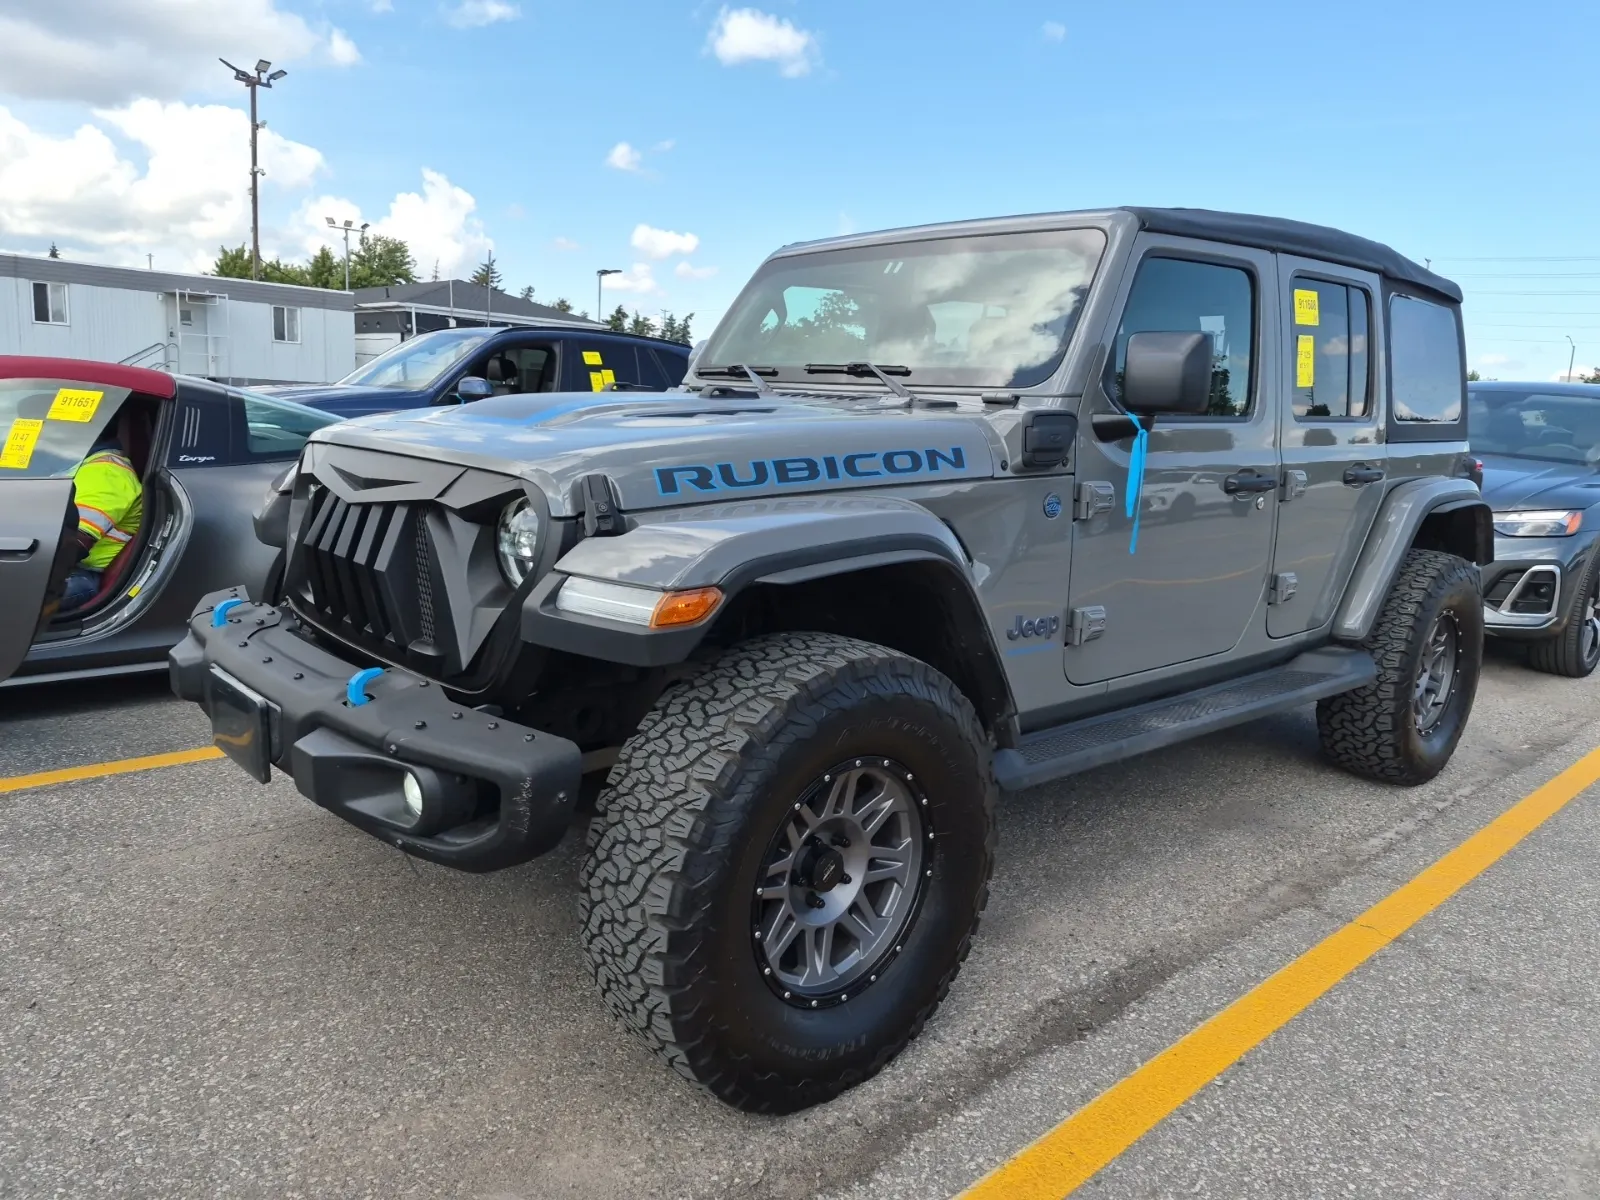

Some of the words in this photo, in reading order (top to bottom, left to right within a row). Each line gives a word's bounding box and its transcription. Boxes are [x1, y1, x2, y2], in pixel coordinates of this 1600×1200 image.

[60, 396, 96, 409] 911651
[179, 454, 216, 463] targa
[654, 447, 966, 495] RUBICON
[1006, 615, 1060, 641] Jeep
